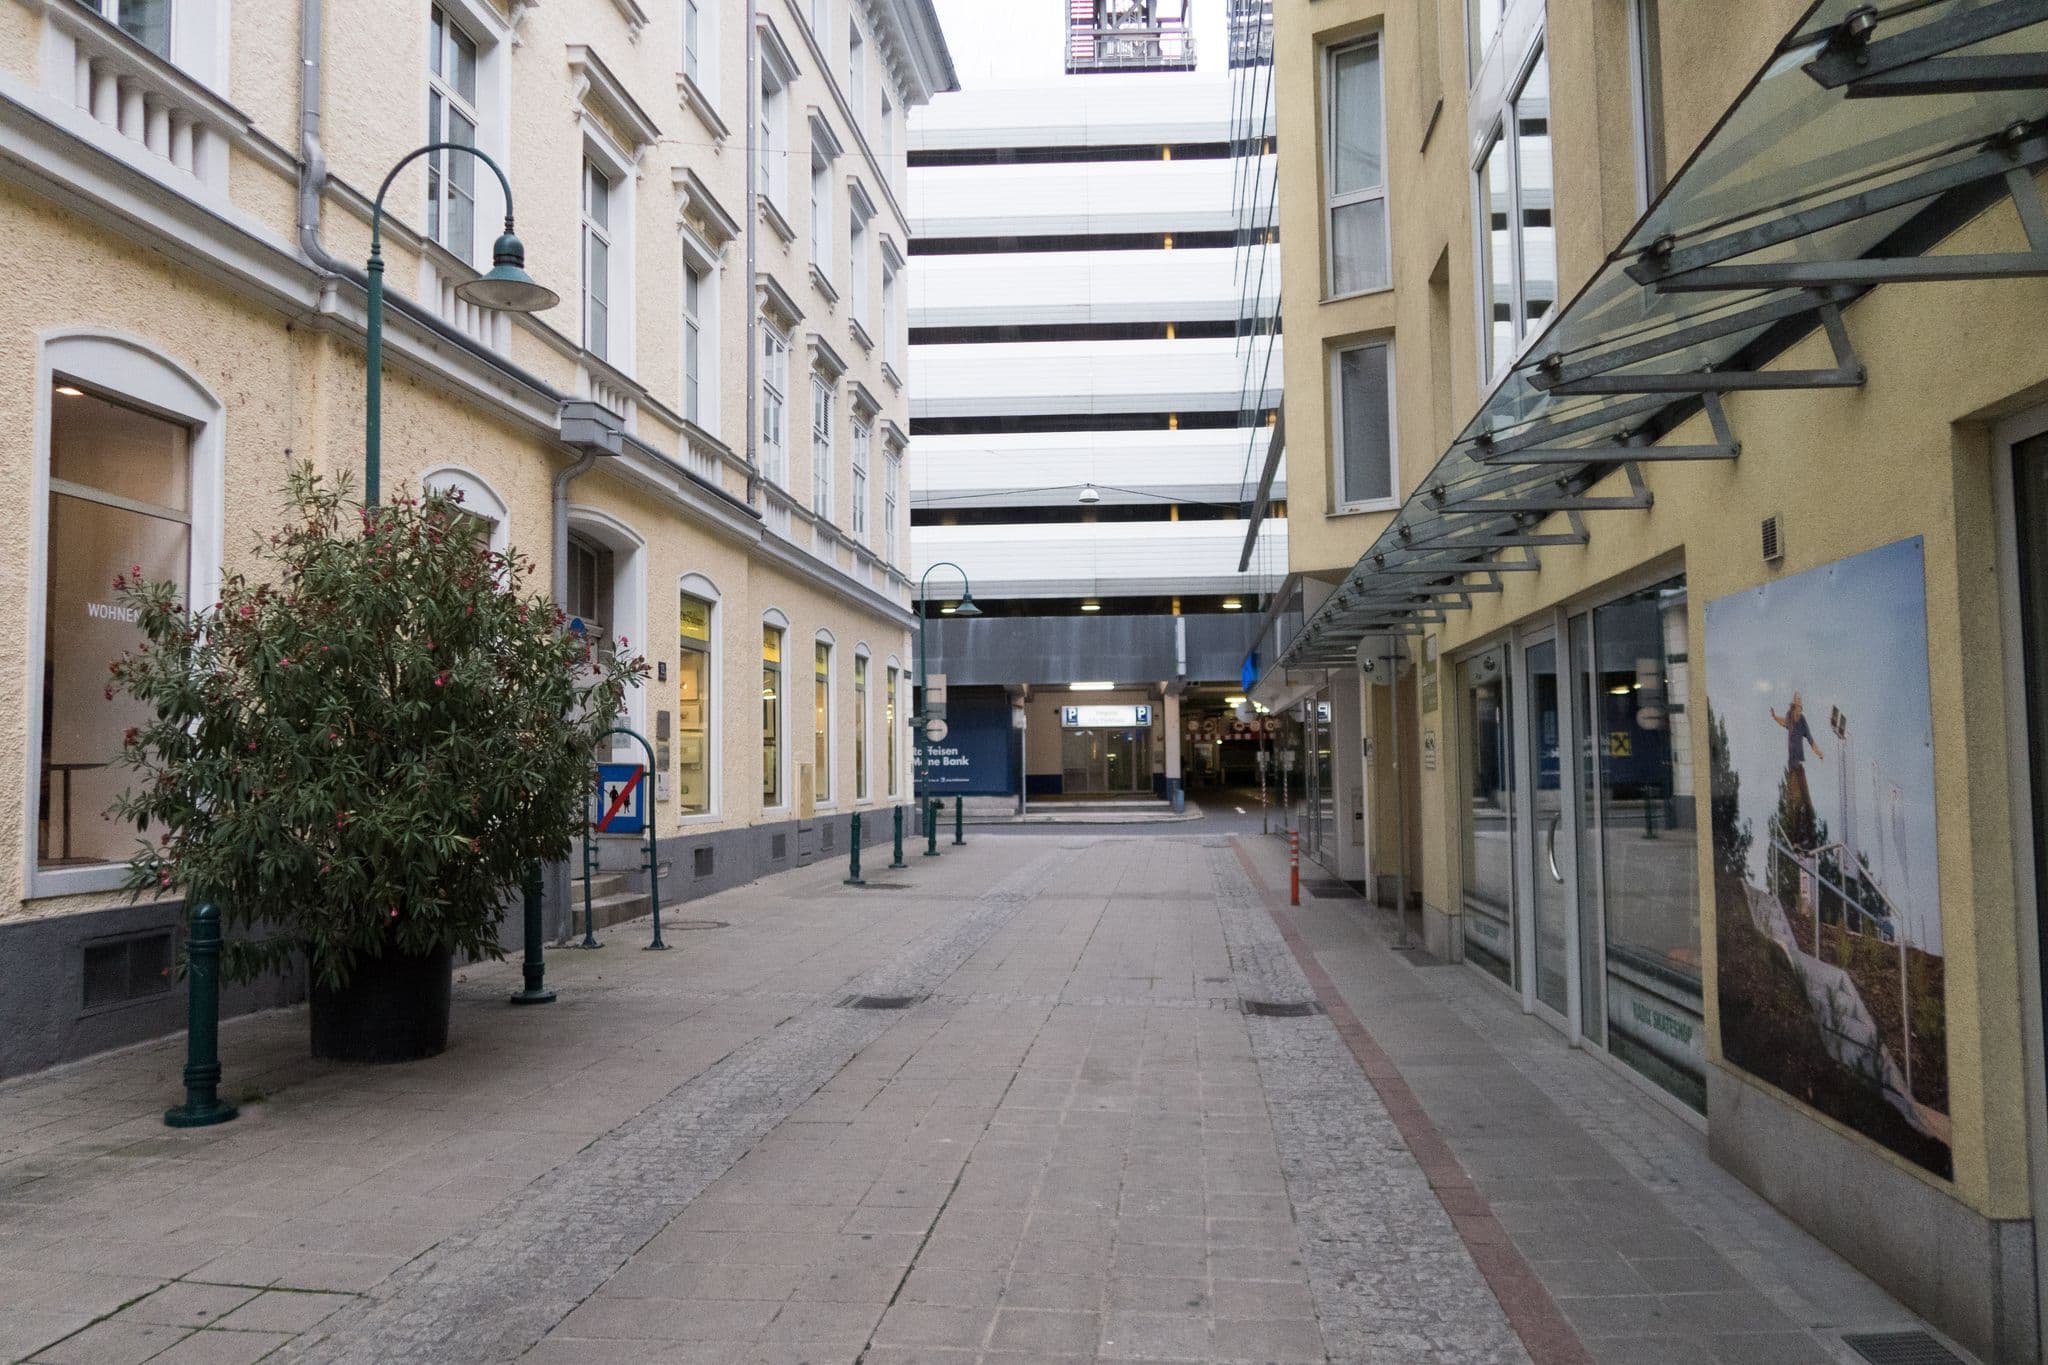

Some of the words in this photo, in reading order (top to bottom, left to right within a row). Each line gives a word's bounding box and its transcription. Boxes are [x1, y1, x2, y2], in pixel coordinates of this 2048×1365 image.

[1068, 708, 1077, 720] P
[1137, 706, 1147, 719] P
[943, 755, 969, 766] Bank
